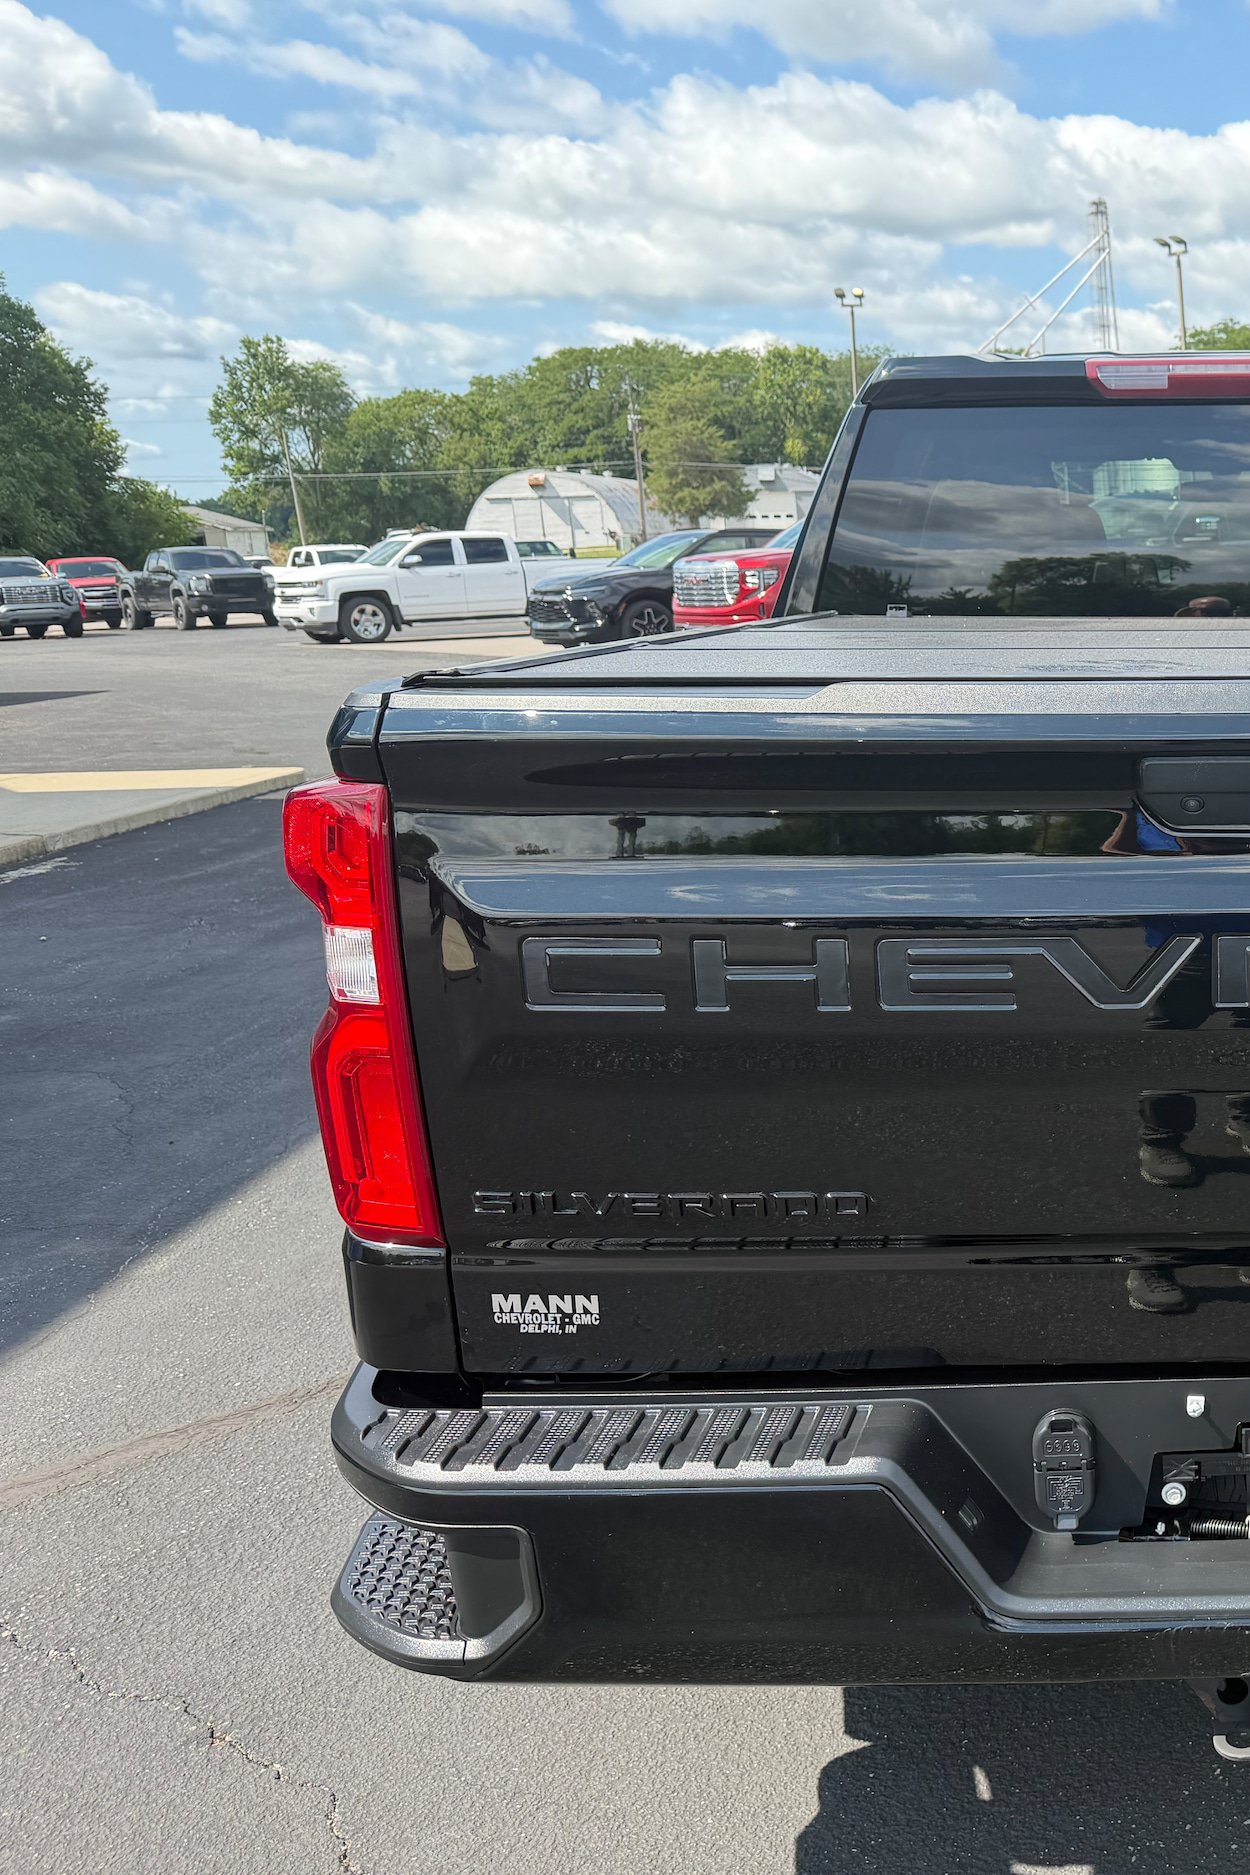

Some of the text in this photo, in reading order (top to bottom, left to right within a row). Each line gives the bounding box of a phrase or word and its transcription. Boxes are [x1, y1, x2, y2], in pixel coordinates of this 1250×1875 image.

[473, 1191, 869, 1217] SILVERADO
[491, 1293, 600, 1314] MANN
[493, 1313, 562, 1324] CHEVROLET
[572, 1313, 600, 1325] GMC
[519, 1324, 578, 1335] DELPHI, IN
